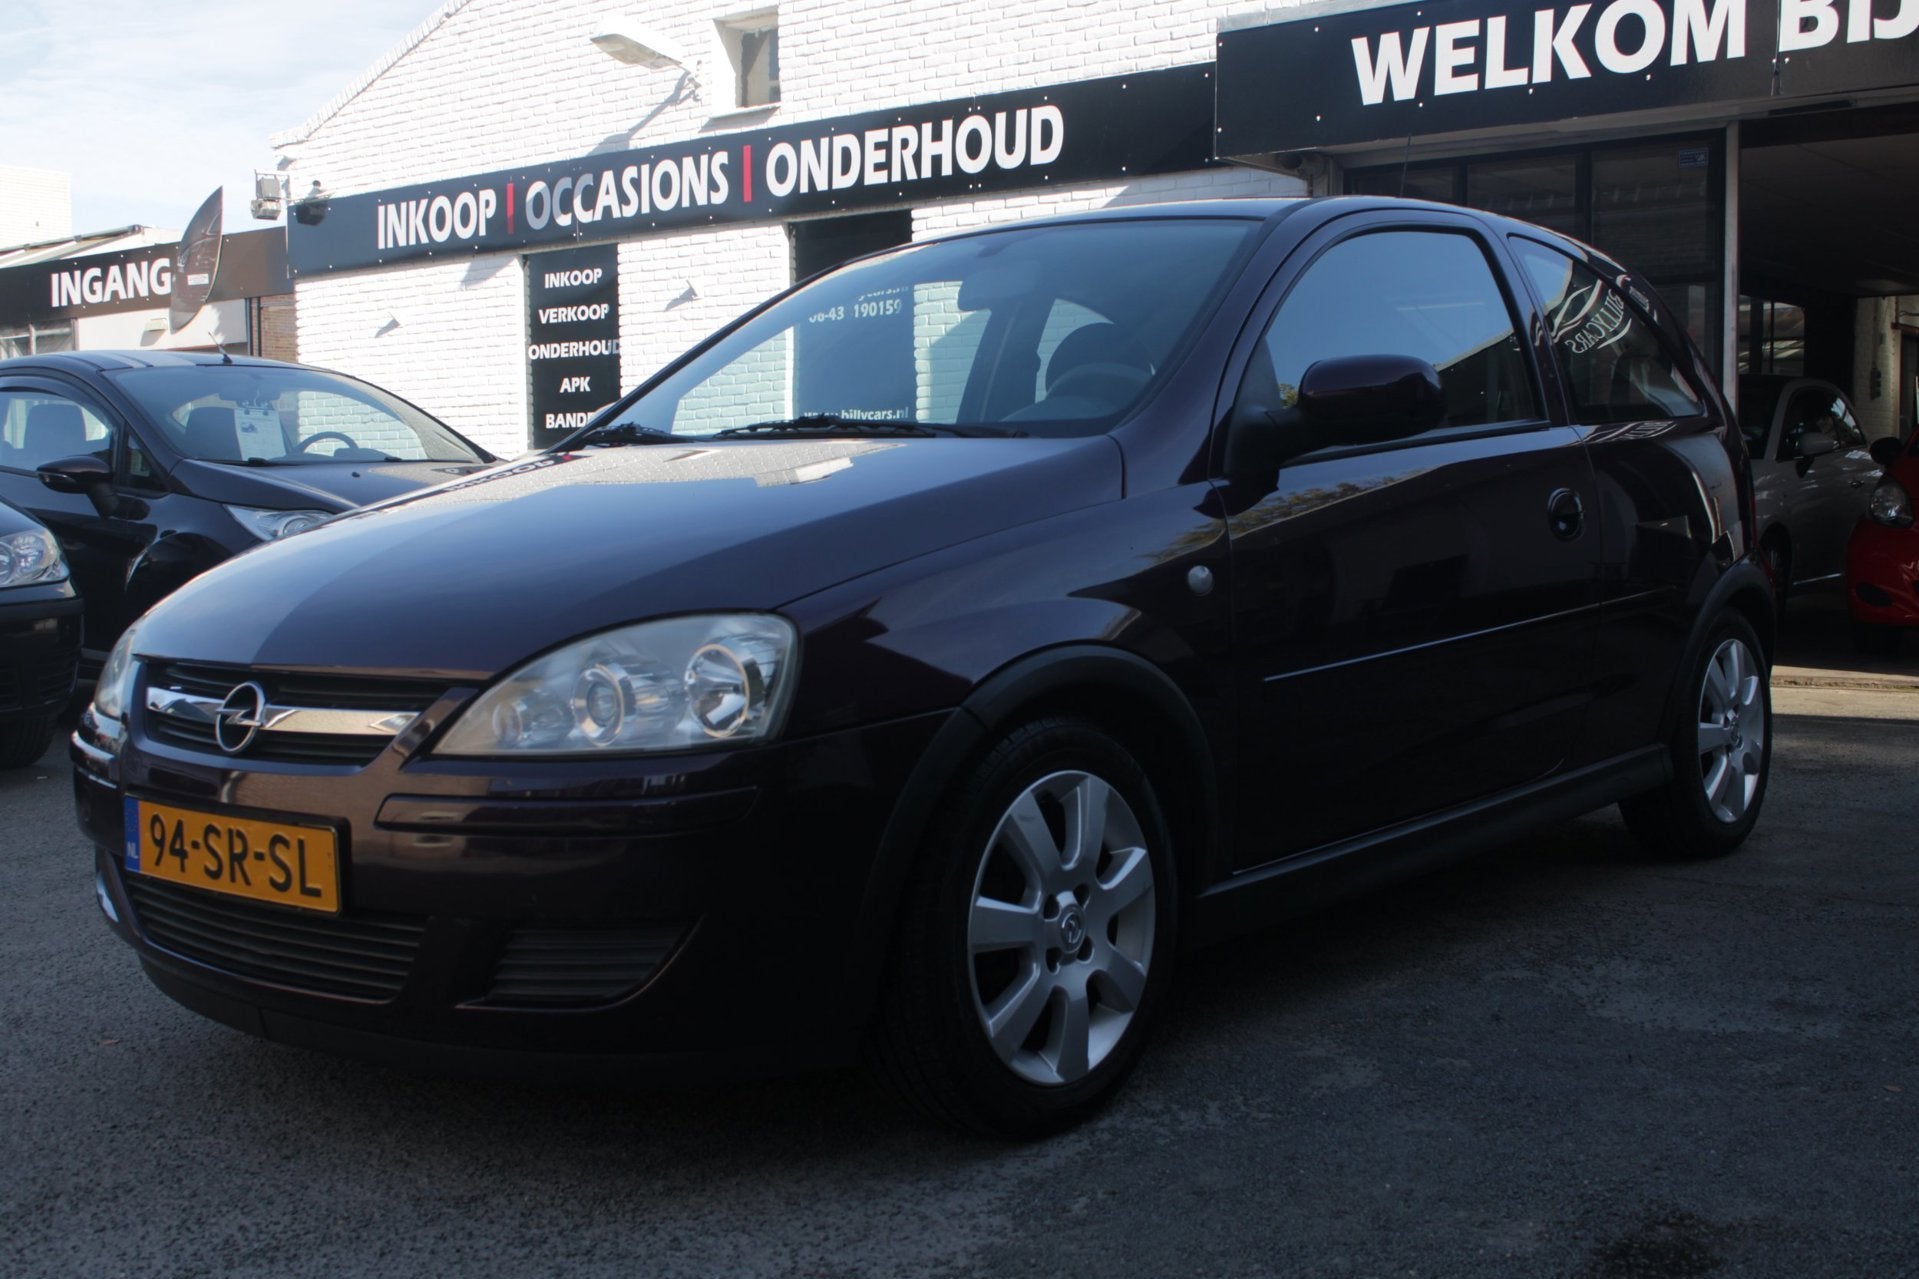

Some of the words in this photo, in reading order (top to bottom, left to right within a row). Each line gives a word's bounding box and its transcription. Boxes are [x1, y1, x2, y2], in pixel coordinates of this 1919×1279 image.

[1350, 0, 1746, 106] WELKOM
[377, 189, 497, 249] INKOOP
[525, 152, 729, 231] OCCASIONS
[766, 104, 1064, 196] ONDERHOUD
[51, 257, 172, 308] INGANG
[544, 268, 603, 289] INKOOP
[538, 304, 610, 325] VERKOOP
[559, 376, 591, 393] APK
[126, 841, 139, 859] NL
[150, 813, 322, 898] 94-SR-SL
